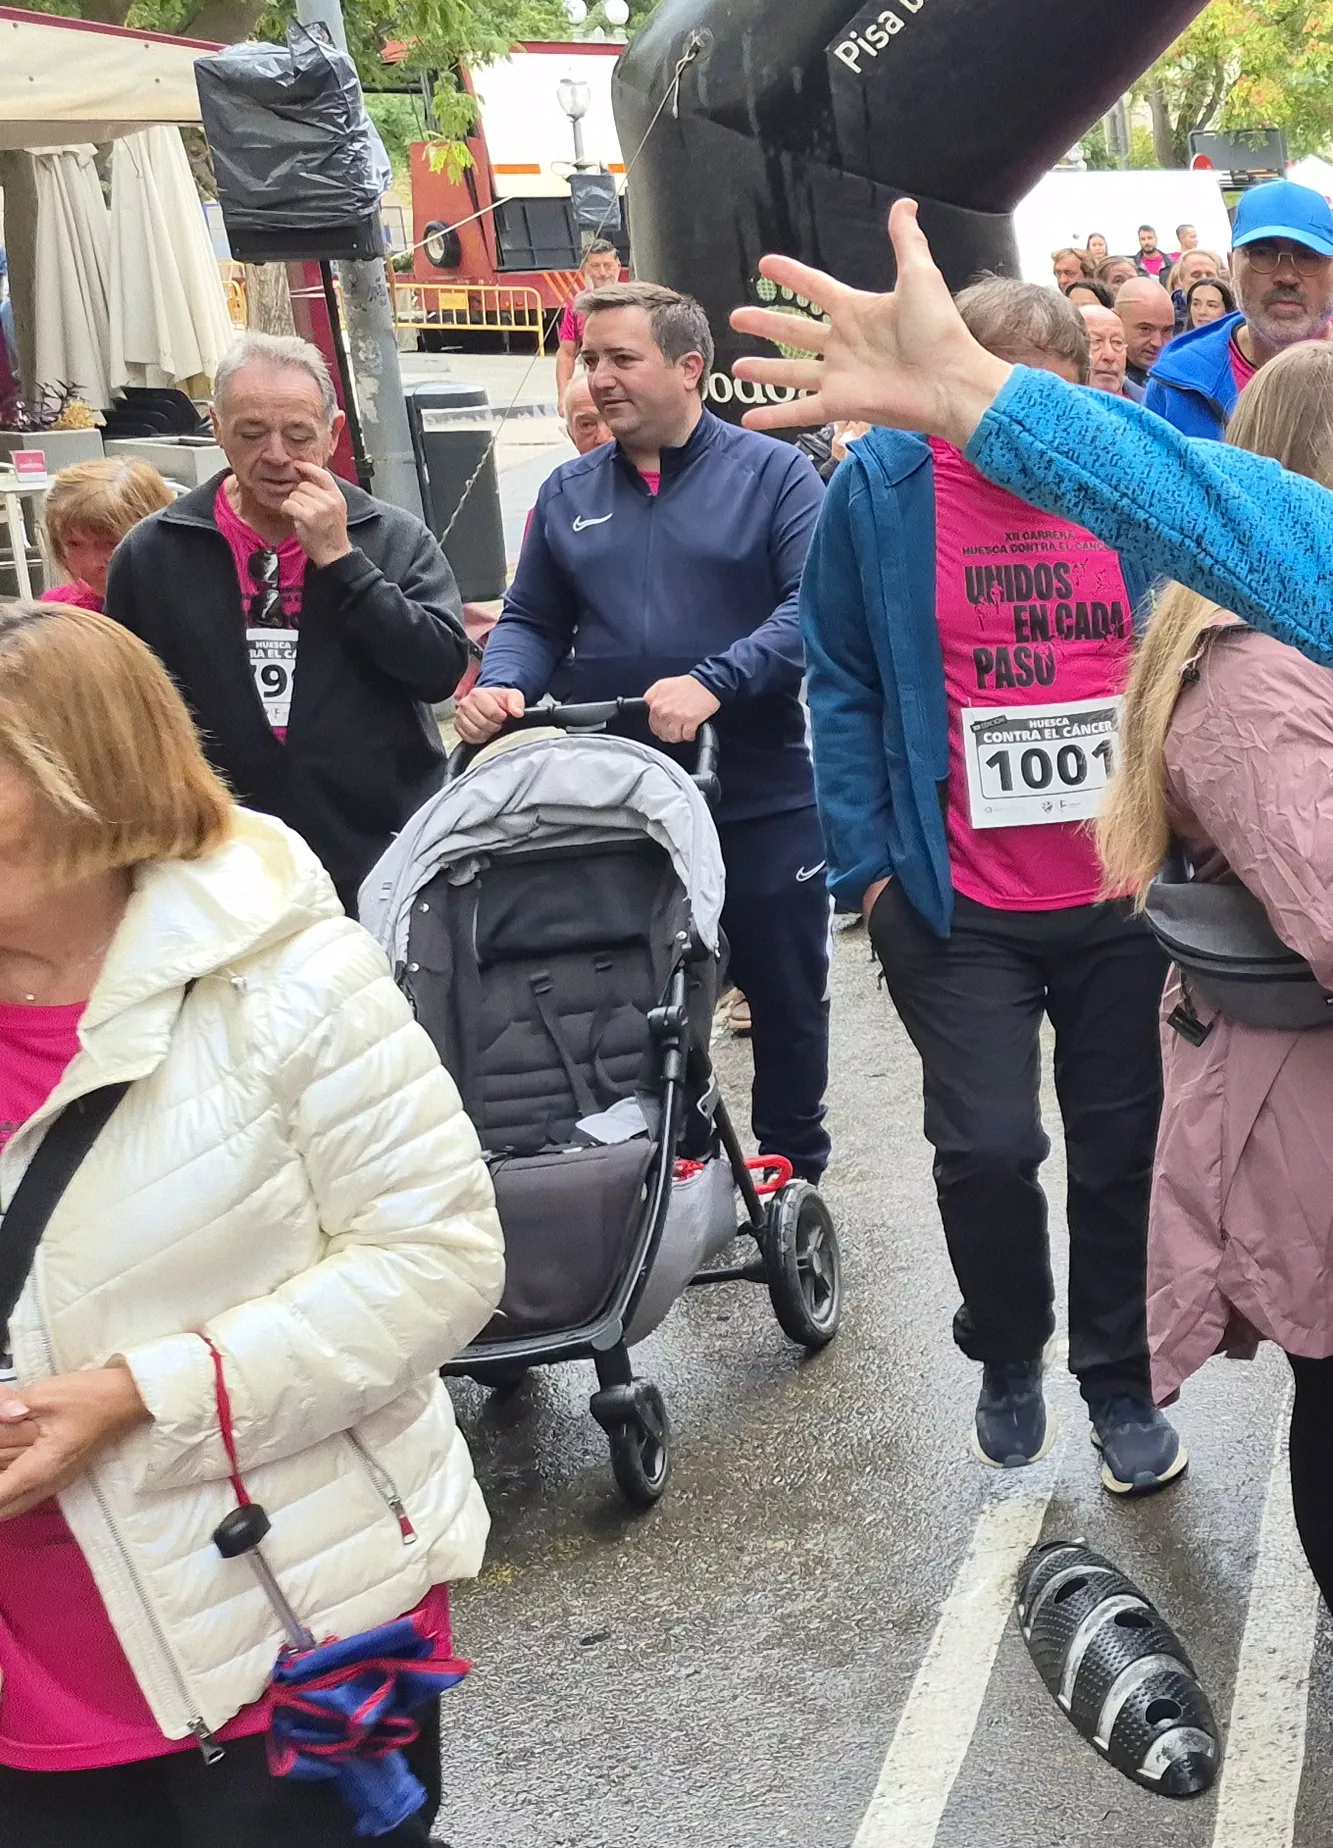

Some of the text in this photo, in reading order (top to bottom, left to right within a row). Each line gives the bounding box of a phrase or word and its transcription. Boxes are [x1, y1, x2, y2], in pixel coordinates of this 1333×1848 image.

[833, 10, 905, 73] Pisa
[963, 545, 1008, 555] HUESCA
[1010, 543, 1056, 554] CONTRA
[1060, 542, 1071, 551] EL
[1022, 530, 1075, 541] CARRERA
[965, 562, 1073, 605] UNIDOS
[1013, 602, 1124, 643] EN CADA
[256, 641, 292, 649] HUESCA
[973, 646, 1057, 689] PASO
[983, 720, 1112, 744] CONTRA EL CÁNCER
[1029, 717, 1070, 729] HUESCA
[985, 739, 1114, 792] 1001
